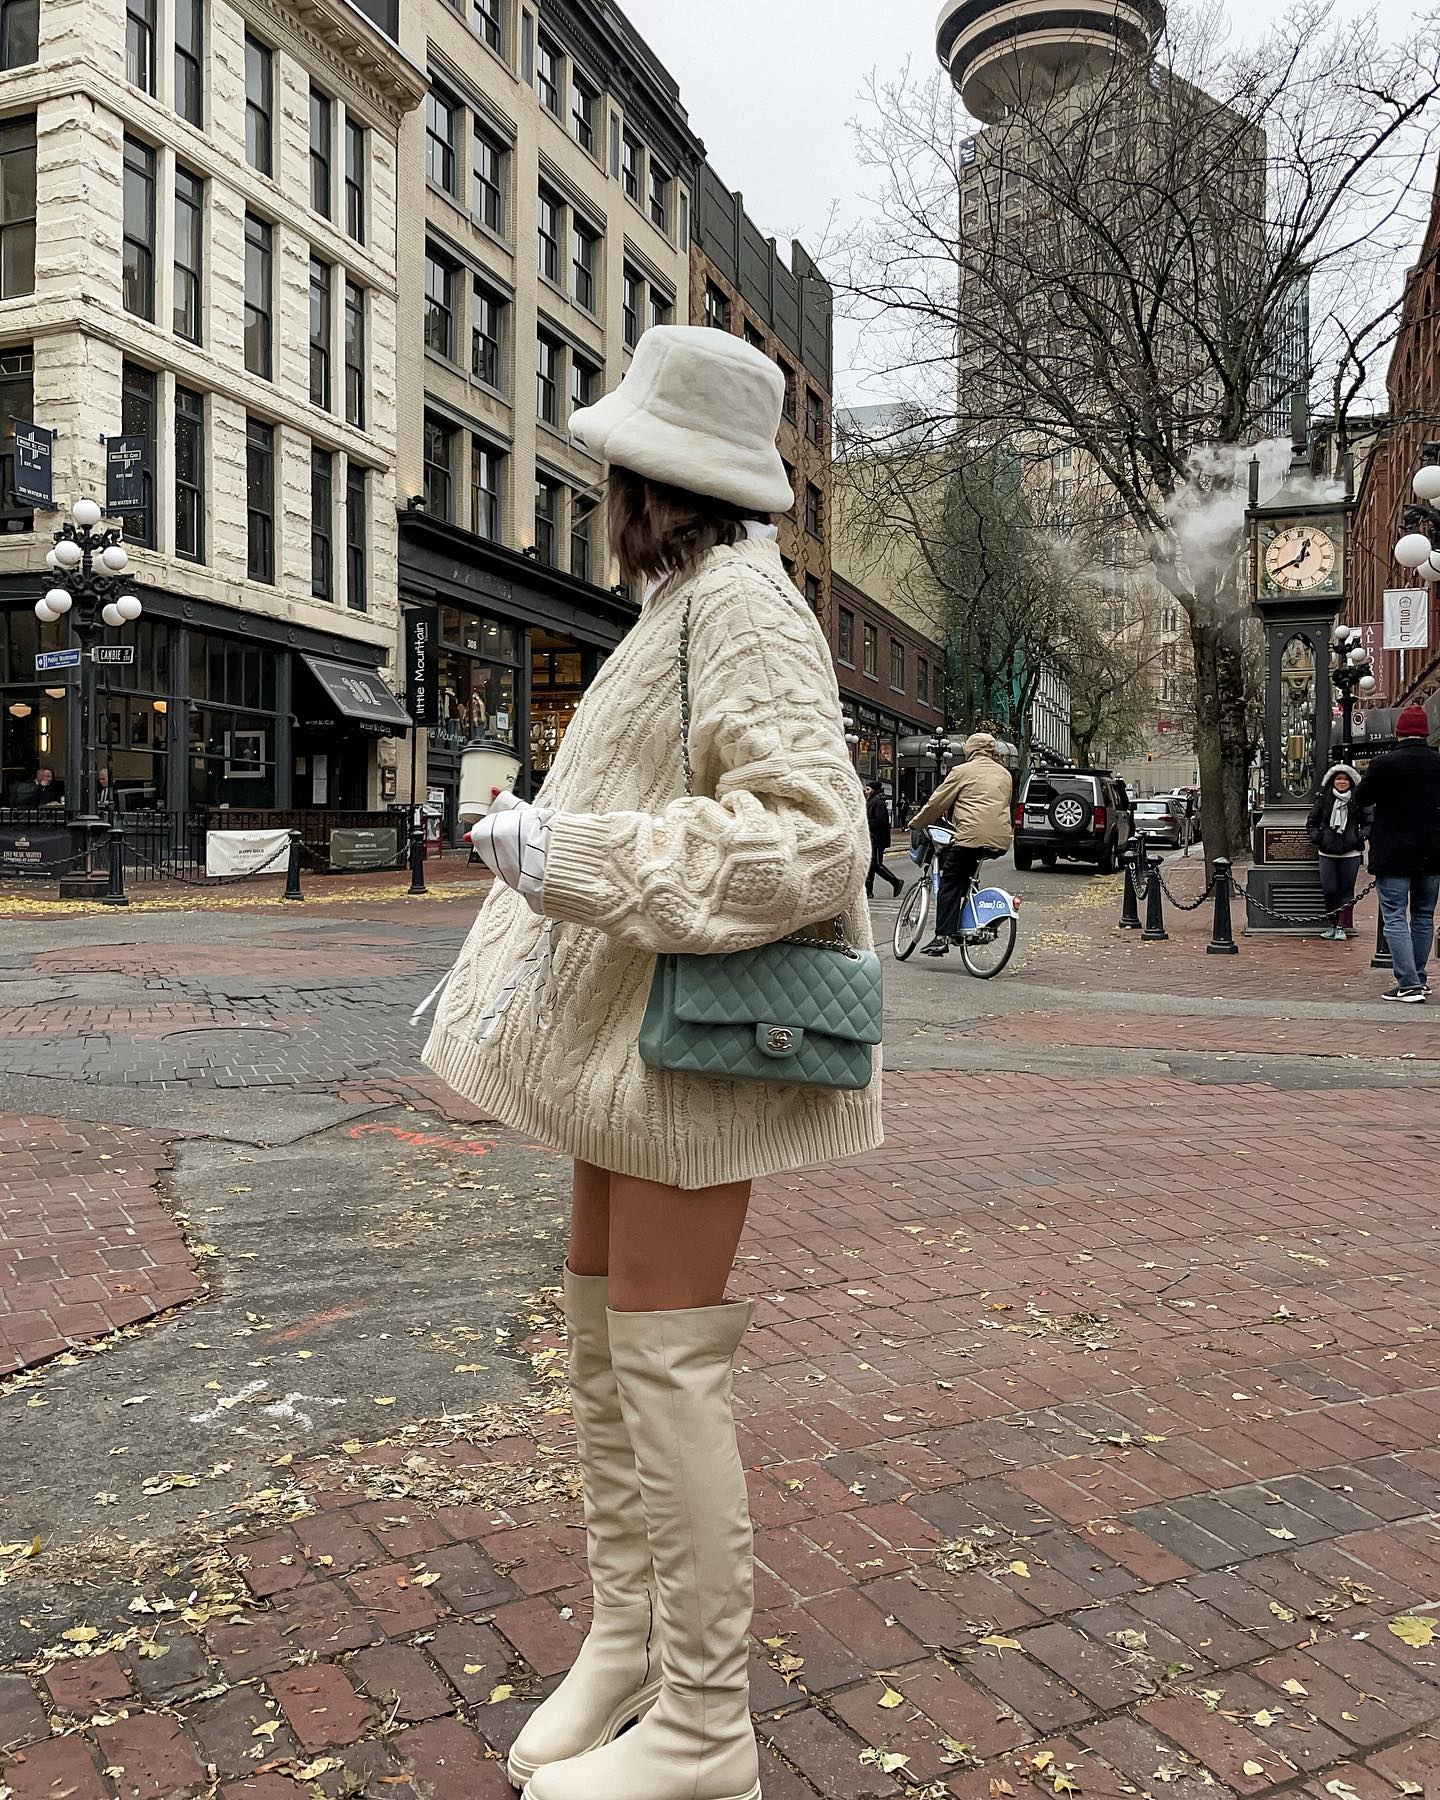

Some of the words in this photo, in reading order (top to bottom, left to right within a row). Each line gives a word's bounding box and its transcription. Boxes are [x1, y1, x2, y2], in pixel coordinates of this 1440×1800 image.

[1400, 609, 1410, 642] SELC
[100, 649, 121, 661] CAMBIE
[414, 622, 425, 682] Mountain
[996, 900, 1005, 909] Go
